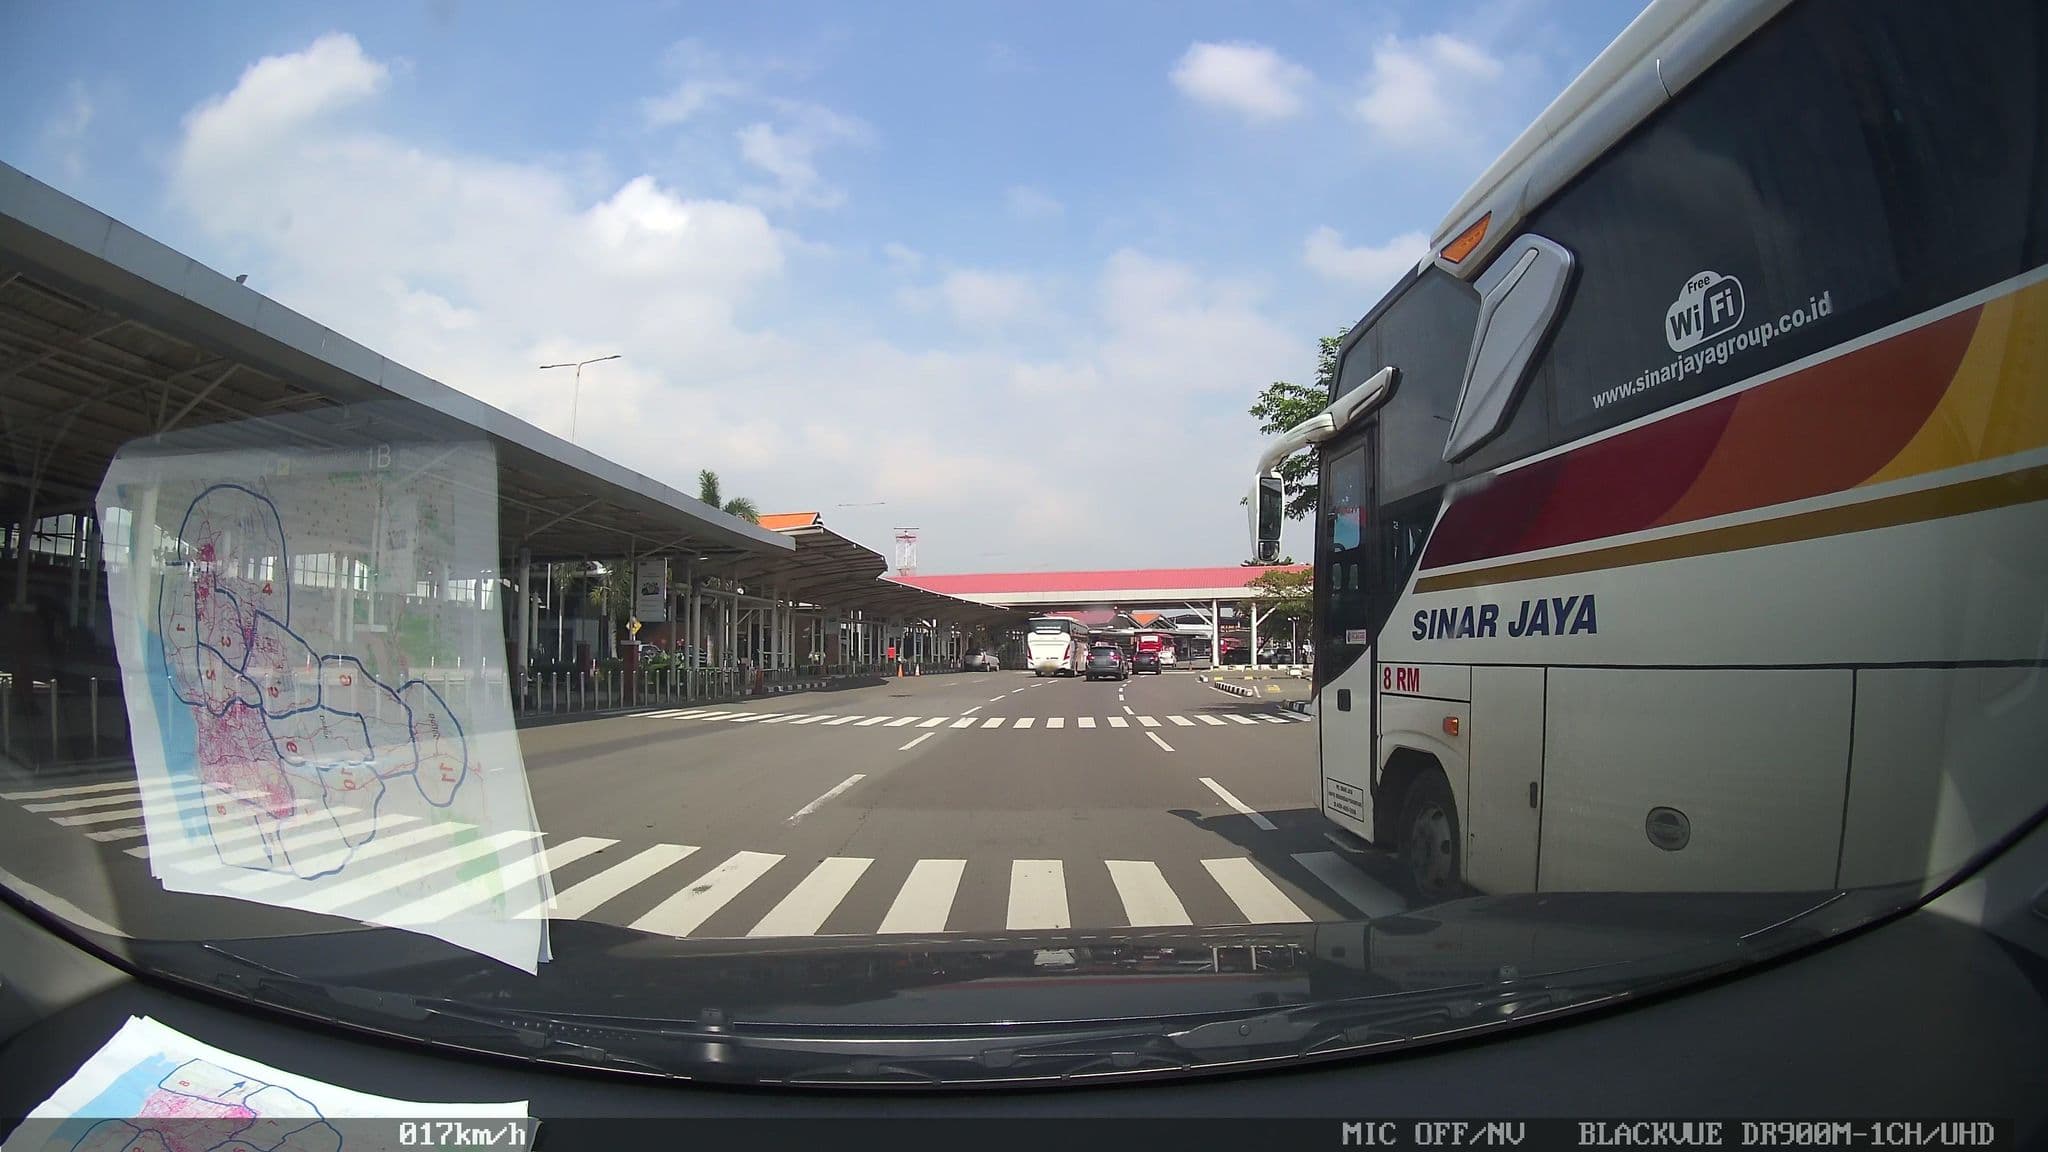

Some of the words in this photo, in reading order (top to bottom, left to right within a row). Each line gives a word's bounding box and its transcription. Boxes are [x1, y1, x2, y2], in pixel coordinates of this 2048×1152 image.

[1687, 275, 1711, 295] Free
[1592, 290, 1834, 410] www.sinarjayagroup.co.id
[1411, 603, 1500, 642] SINAR
[1508, 593, 1598, 638] JAYA
[1383, 666, 1392, 690] 8
[1396, 668, 1420, 693] RM
